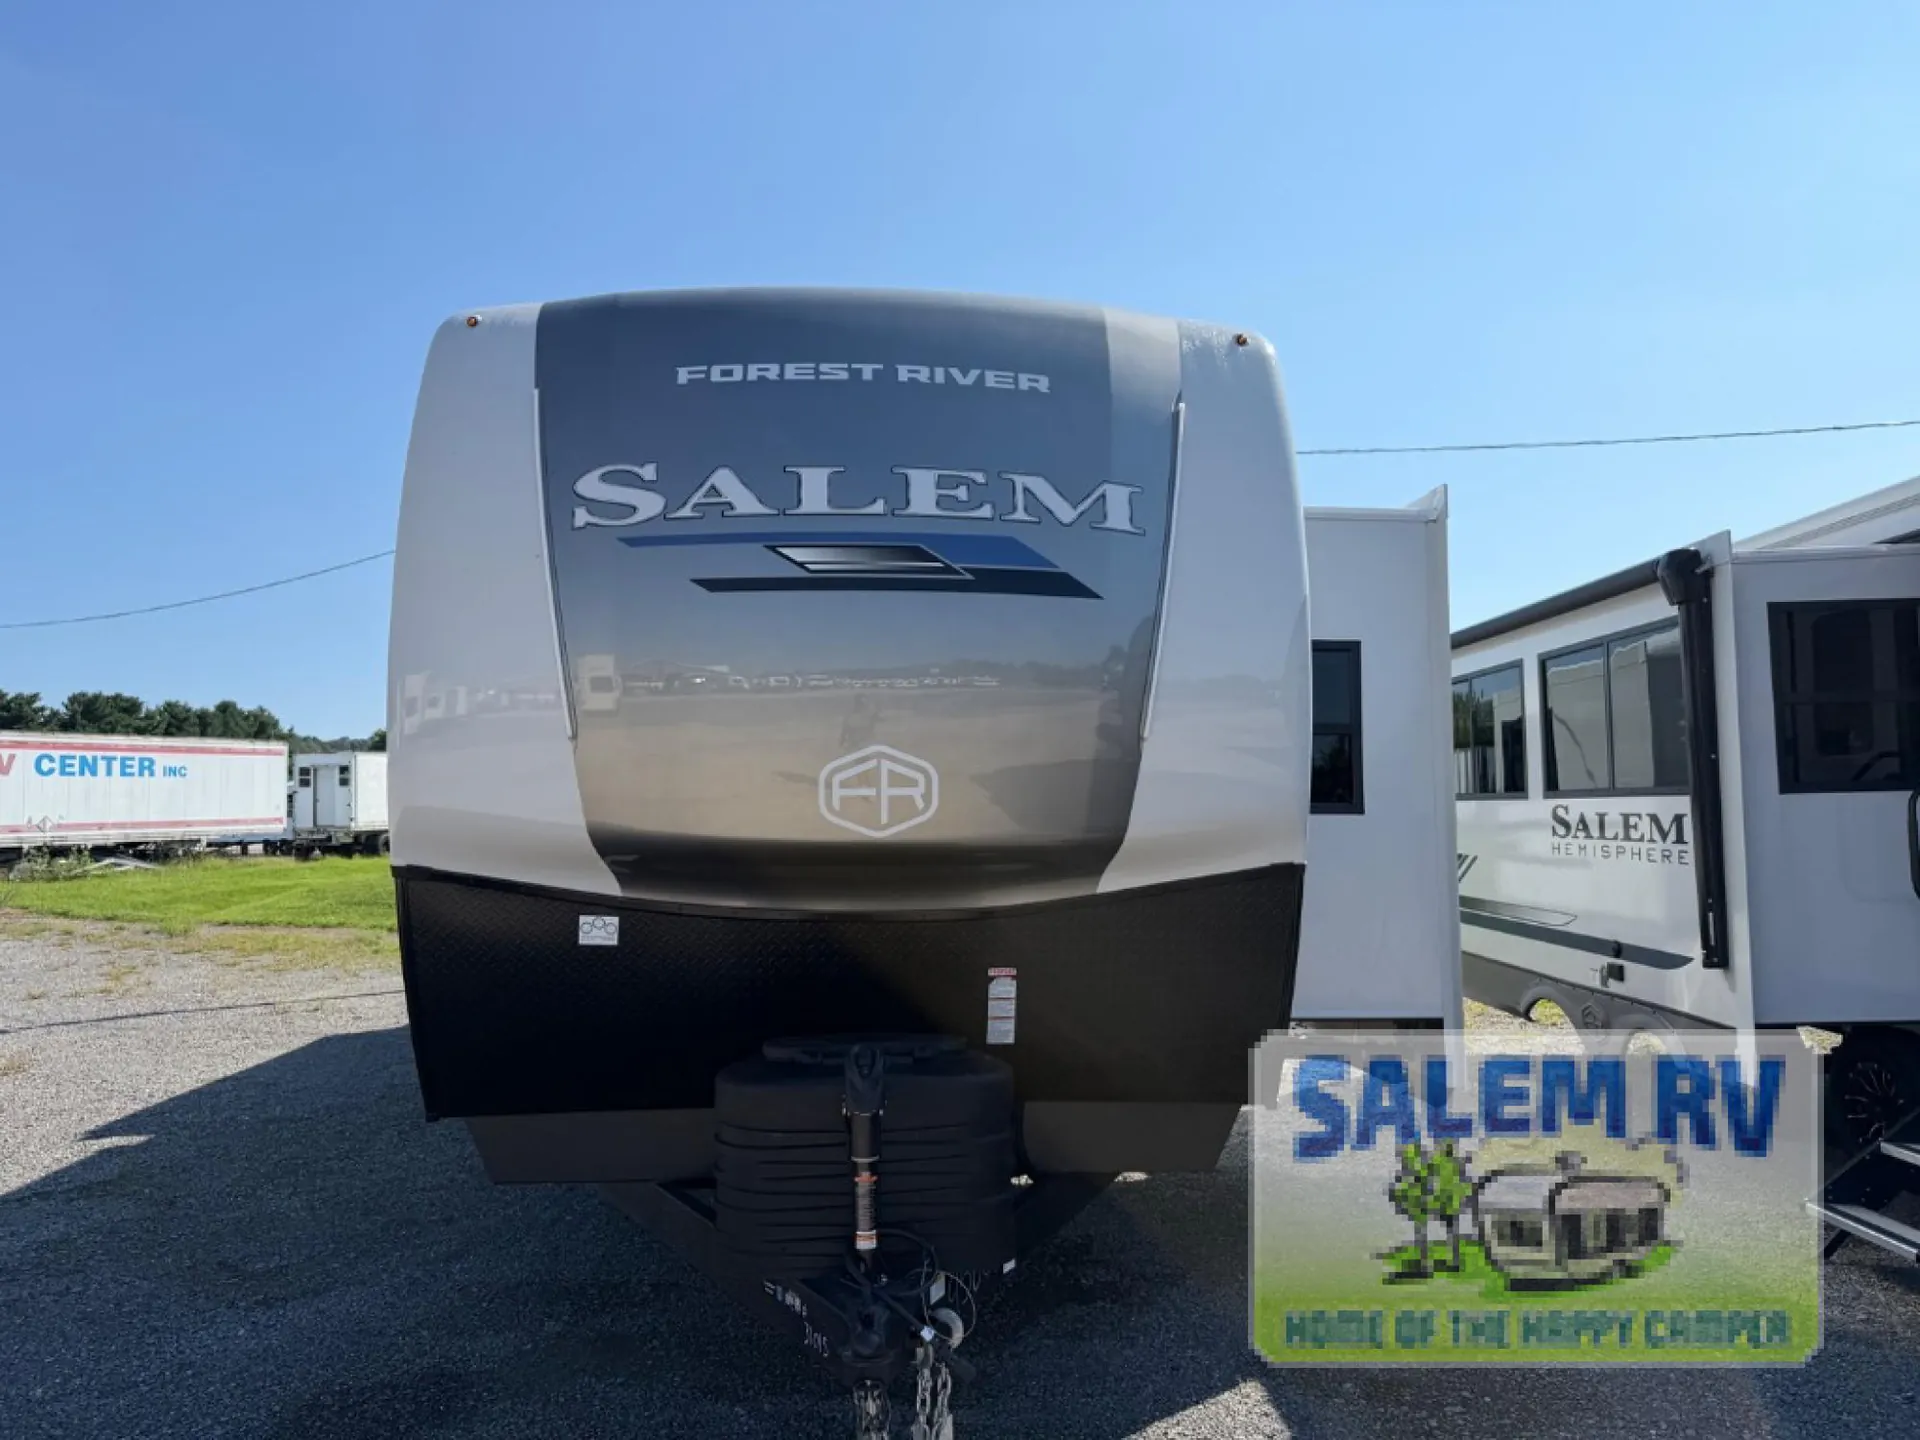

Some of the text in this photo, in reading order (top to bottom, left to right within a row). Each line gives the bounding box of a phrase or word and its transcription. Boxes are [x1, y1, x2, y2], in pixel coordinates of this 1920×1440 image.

[676, 363, 1051, 393] FOREST RIVER
[571, 461, 1146, 536] SALEM
[33, 753, 156, 778] CENTER
[162, 765, 188, 778] INC
[1551, 804, 1689, 845] SALEM
[1551, 841, 1690, 866] HEMISPHERE
